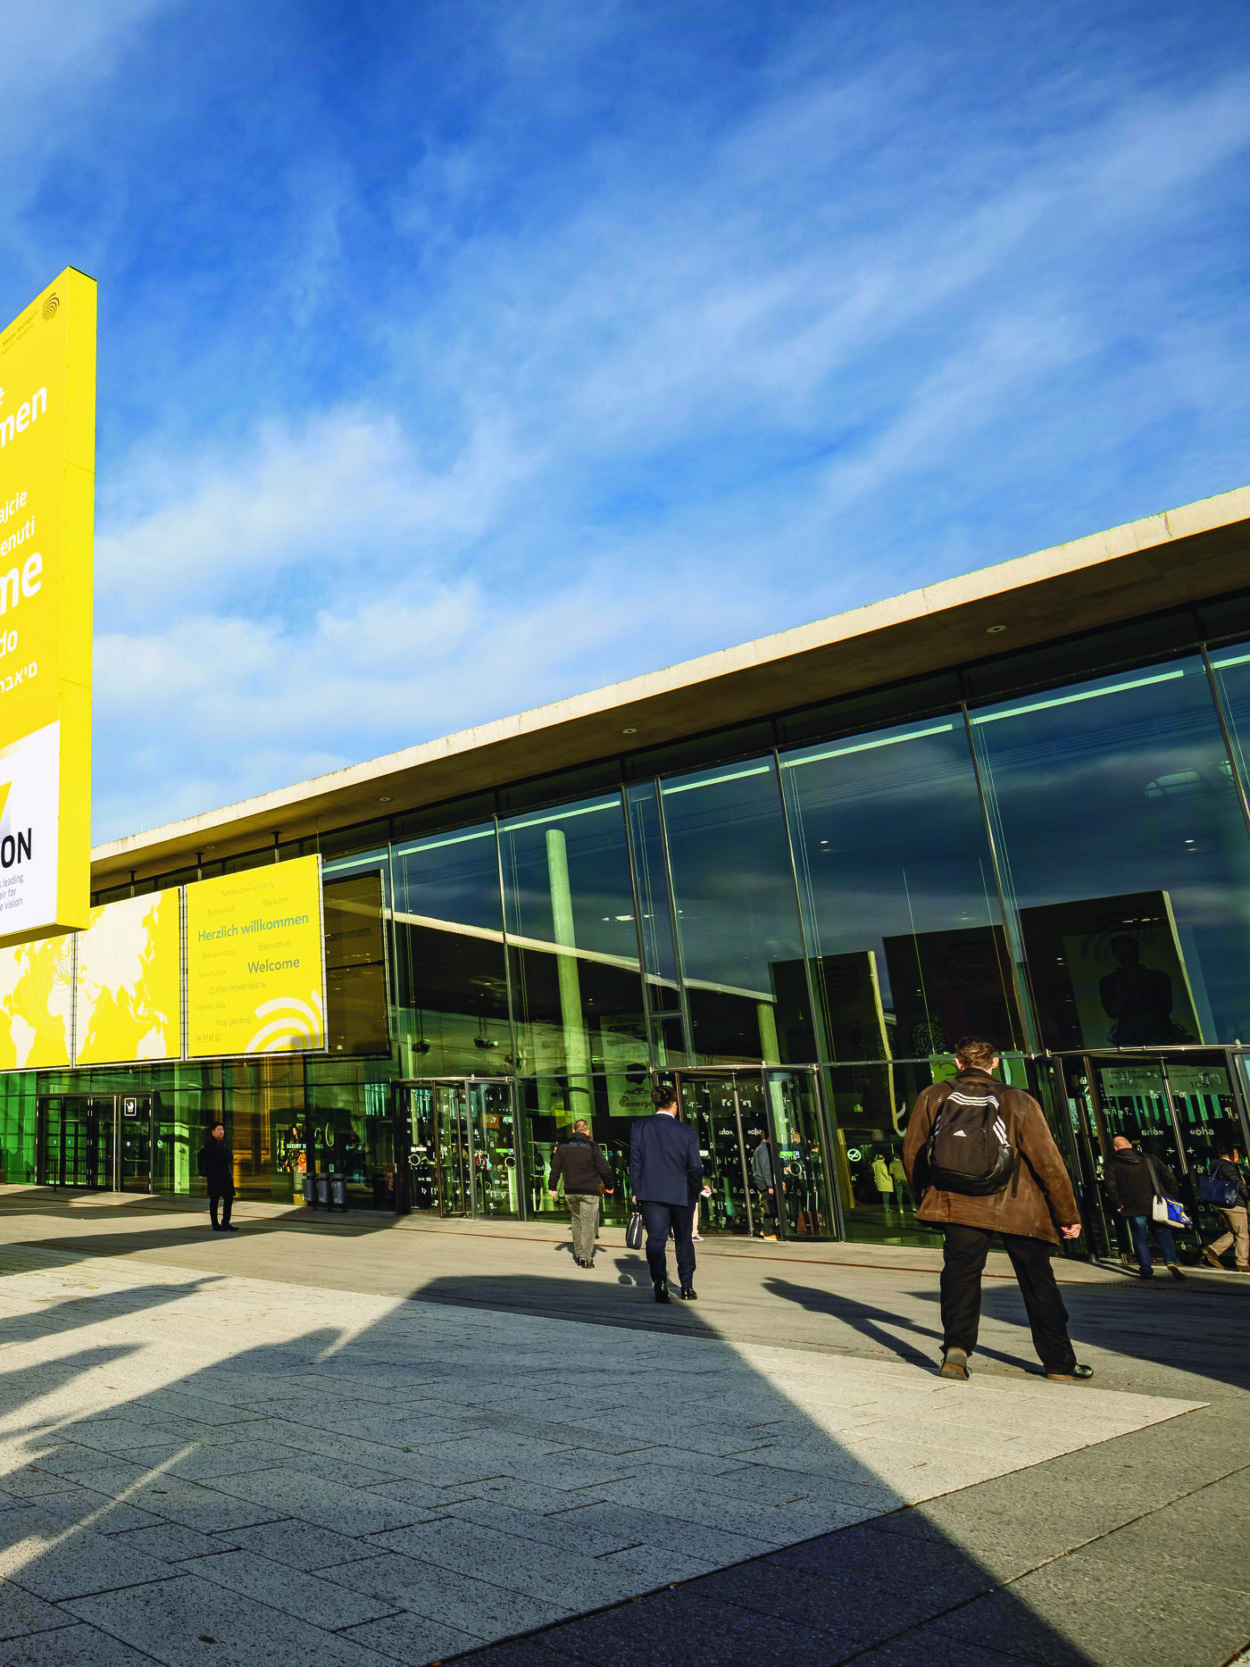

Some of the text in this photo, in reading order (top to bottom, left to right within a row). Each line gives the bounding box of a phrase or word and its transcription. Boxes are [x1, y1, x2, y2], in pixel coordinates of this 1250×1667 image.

[2, 874, 24, 891] leading
[7, 887, 17, 898] for
[4, 897, 23, 910] vision
[198, 914, 309, 942] Herzlich willkommen
[247, 958, 300, 975] Welcome
